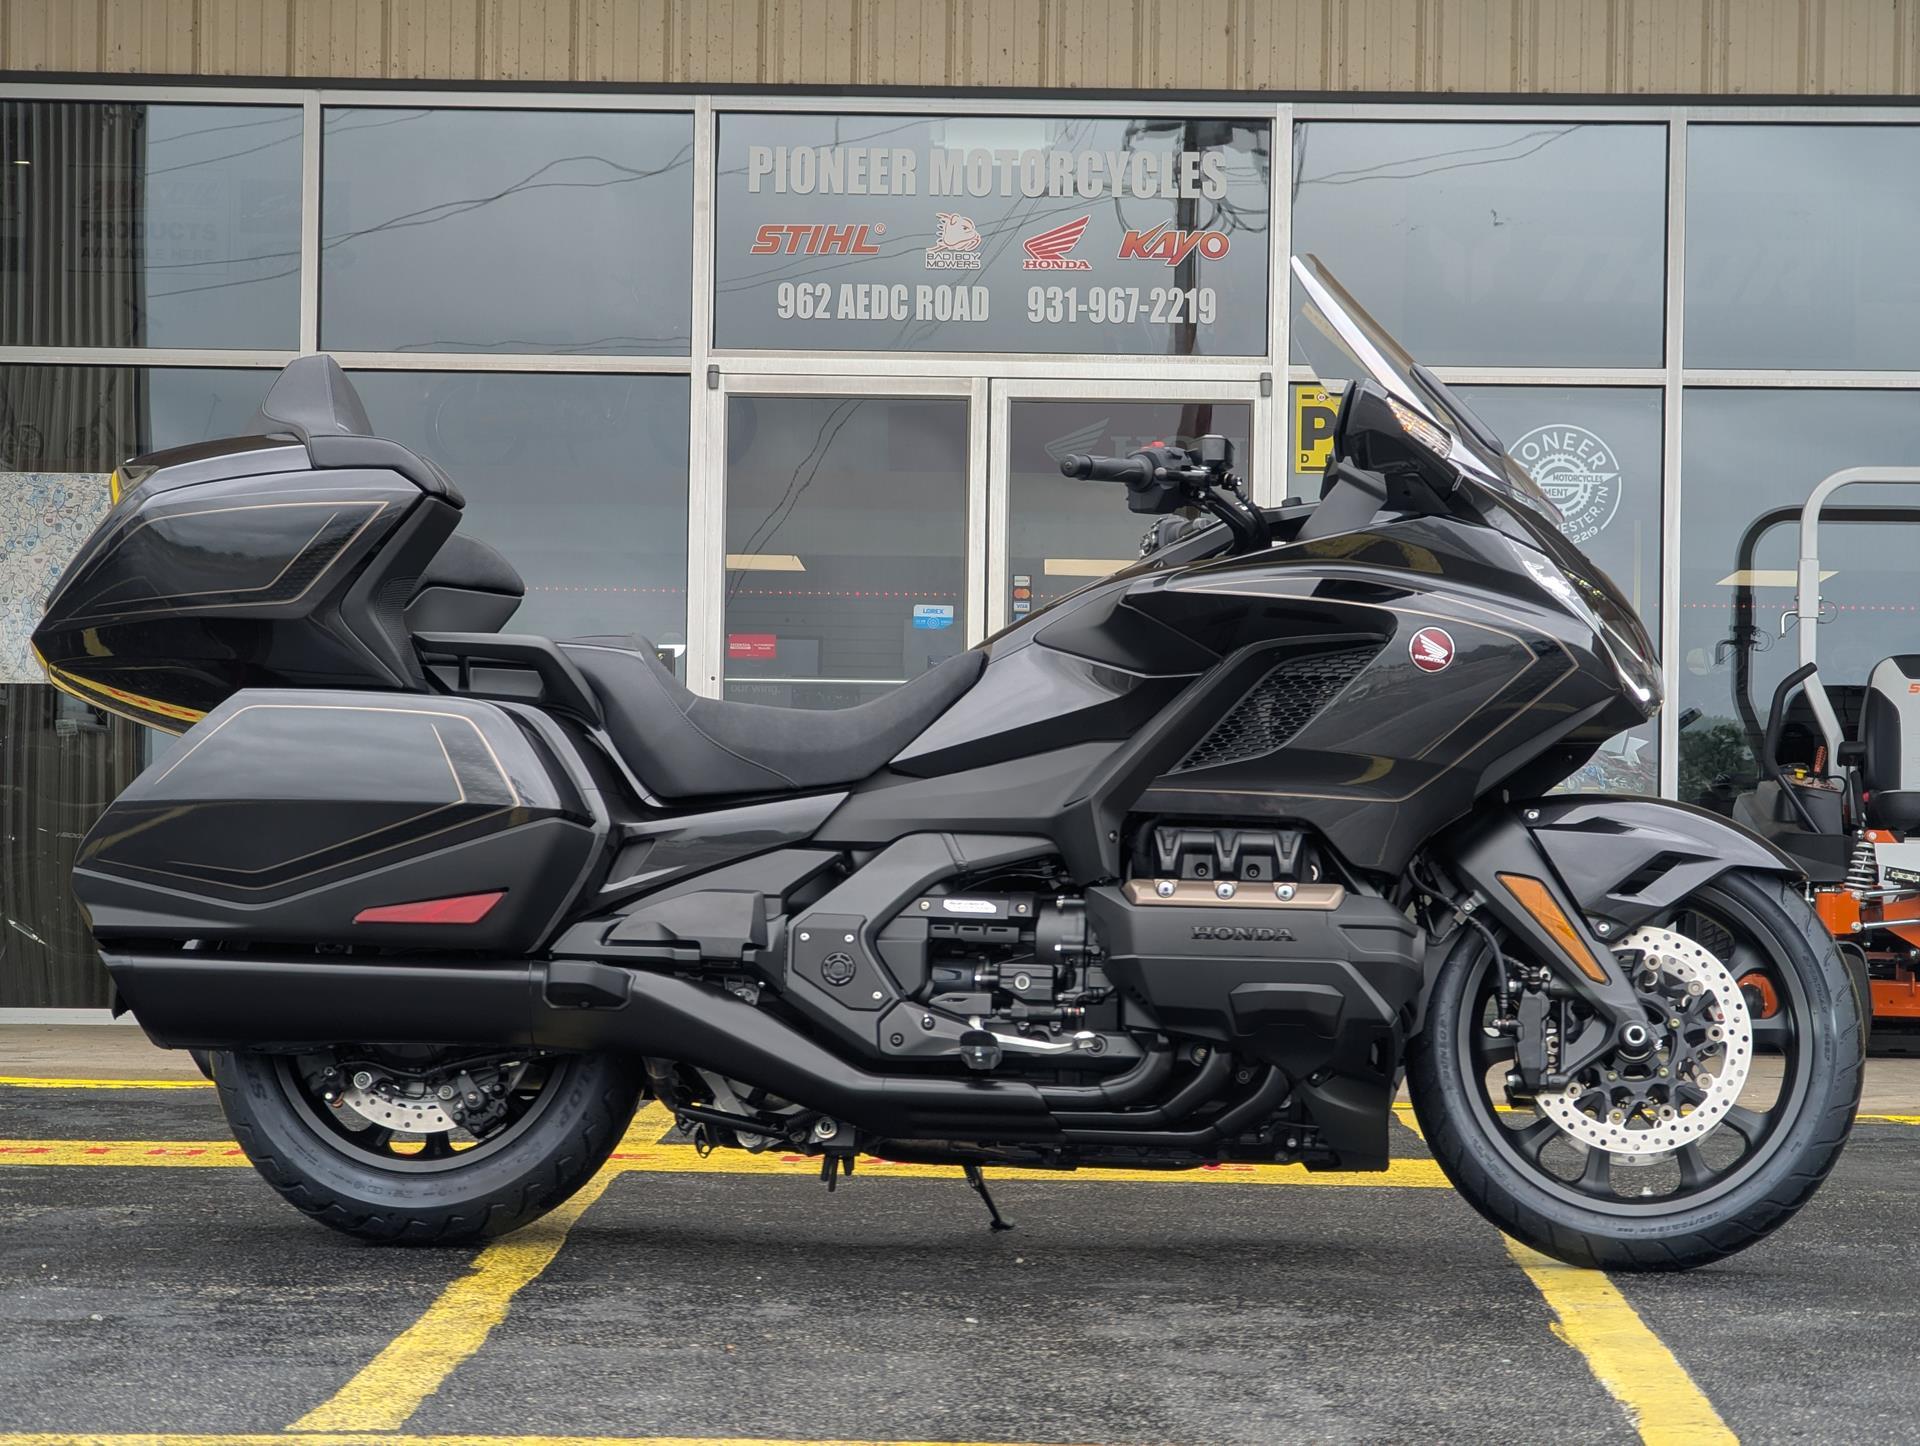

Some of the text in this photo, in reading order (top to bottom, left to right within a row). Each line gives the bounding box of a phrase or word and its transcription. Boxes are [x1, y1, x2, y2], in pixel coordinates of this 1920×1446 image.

[748, 146, 1228, 199] PIONEER MOTORCYCLES
[1118, 219, 1230, 267] KAYO
[926, 253, 980, 261] BAD BOY
[926, 260, 980, 269] MOWERS
[1023, 259, 1092, 270] HONDA
[777, 282, 990, 321] 962 AEDC ROAD
[1027, 286, 1217, 324] 931-967-2219
[1552, 473, 1604, 483] MOTORCYCLES
[1191, 926, 1298, 942] HONDA
